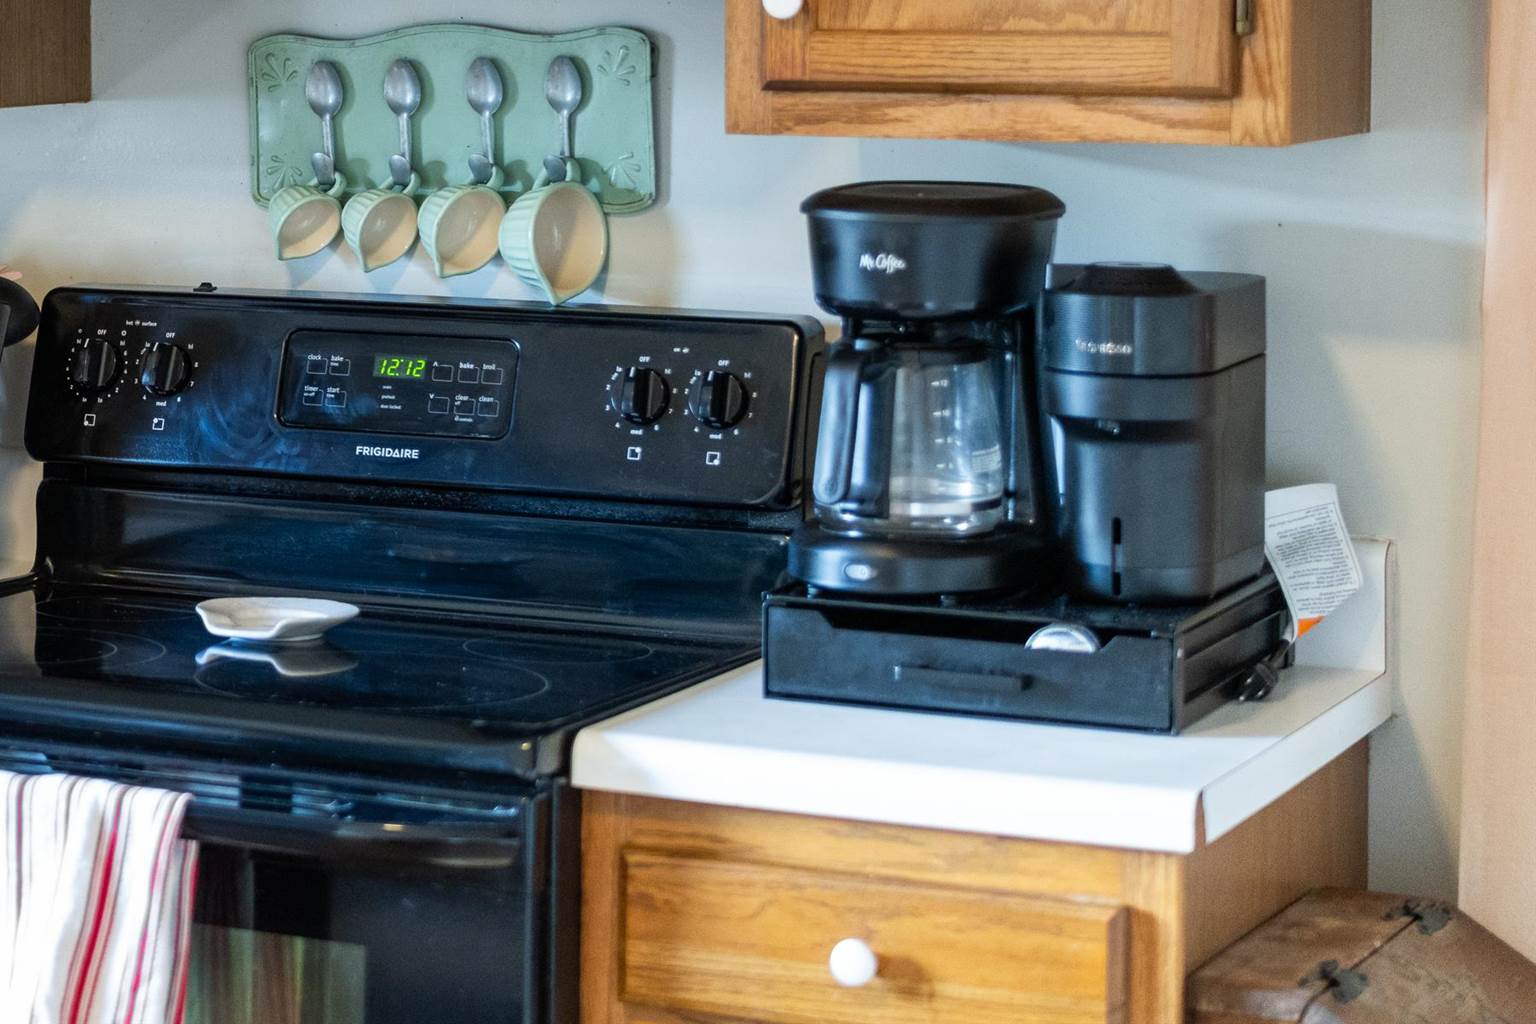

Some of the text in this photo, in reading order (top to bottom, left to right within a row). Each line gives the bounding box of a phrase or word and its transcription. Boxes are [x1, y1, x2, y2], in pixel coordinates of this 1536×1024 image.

[875, 253, 906, 274] Coffee
[379, 358, 426, 377] 12:12
[355, 446, 420, 459] FRIGIDAIRE
